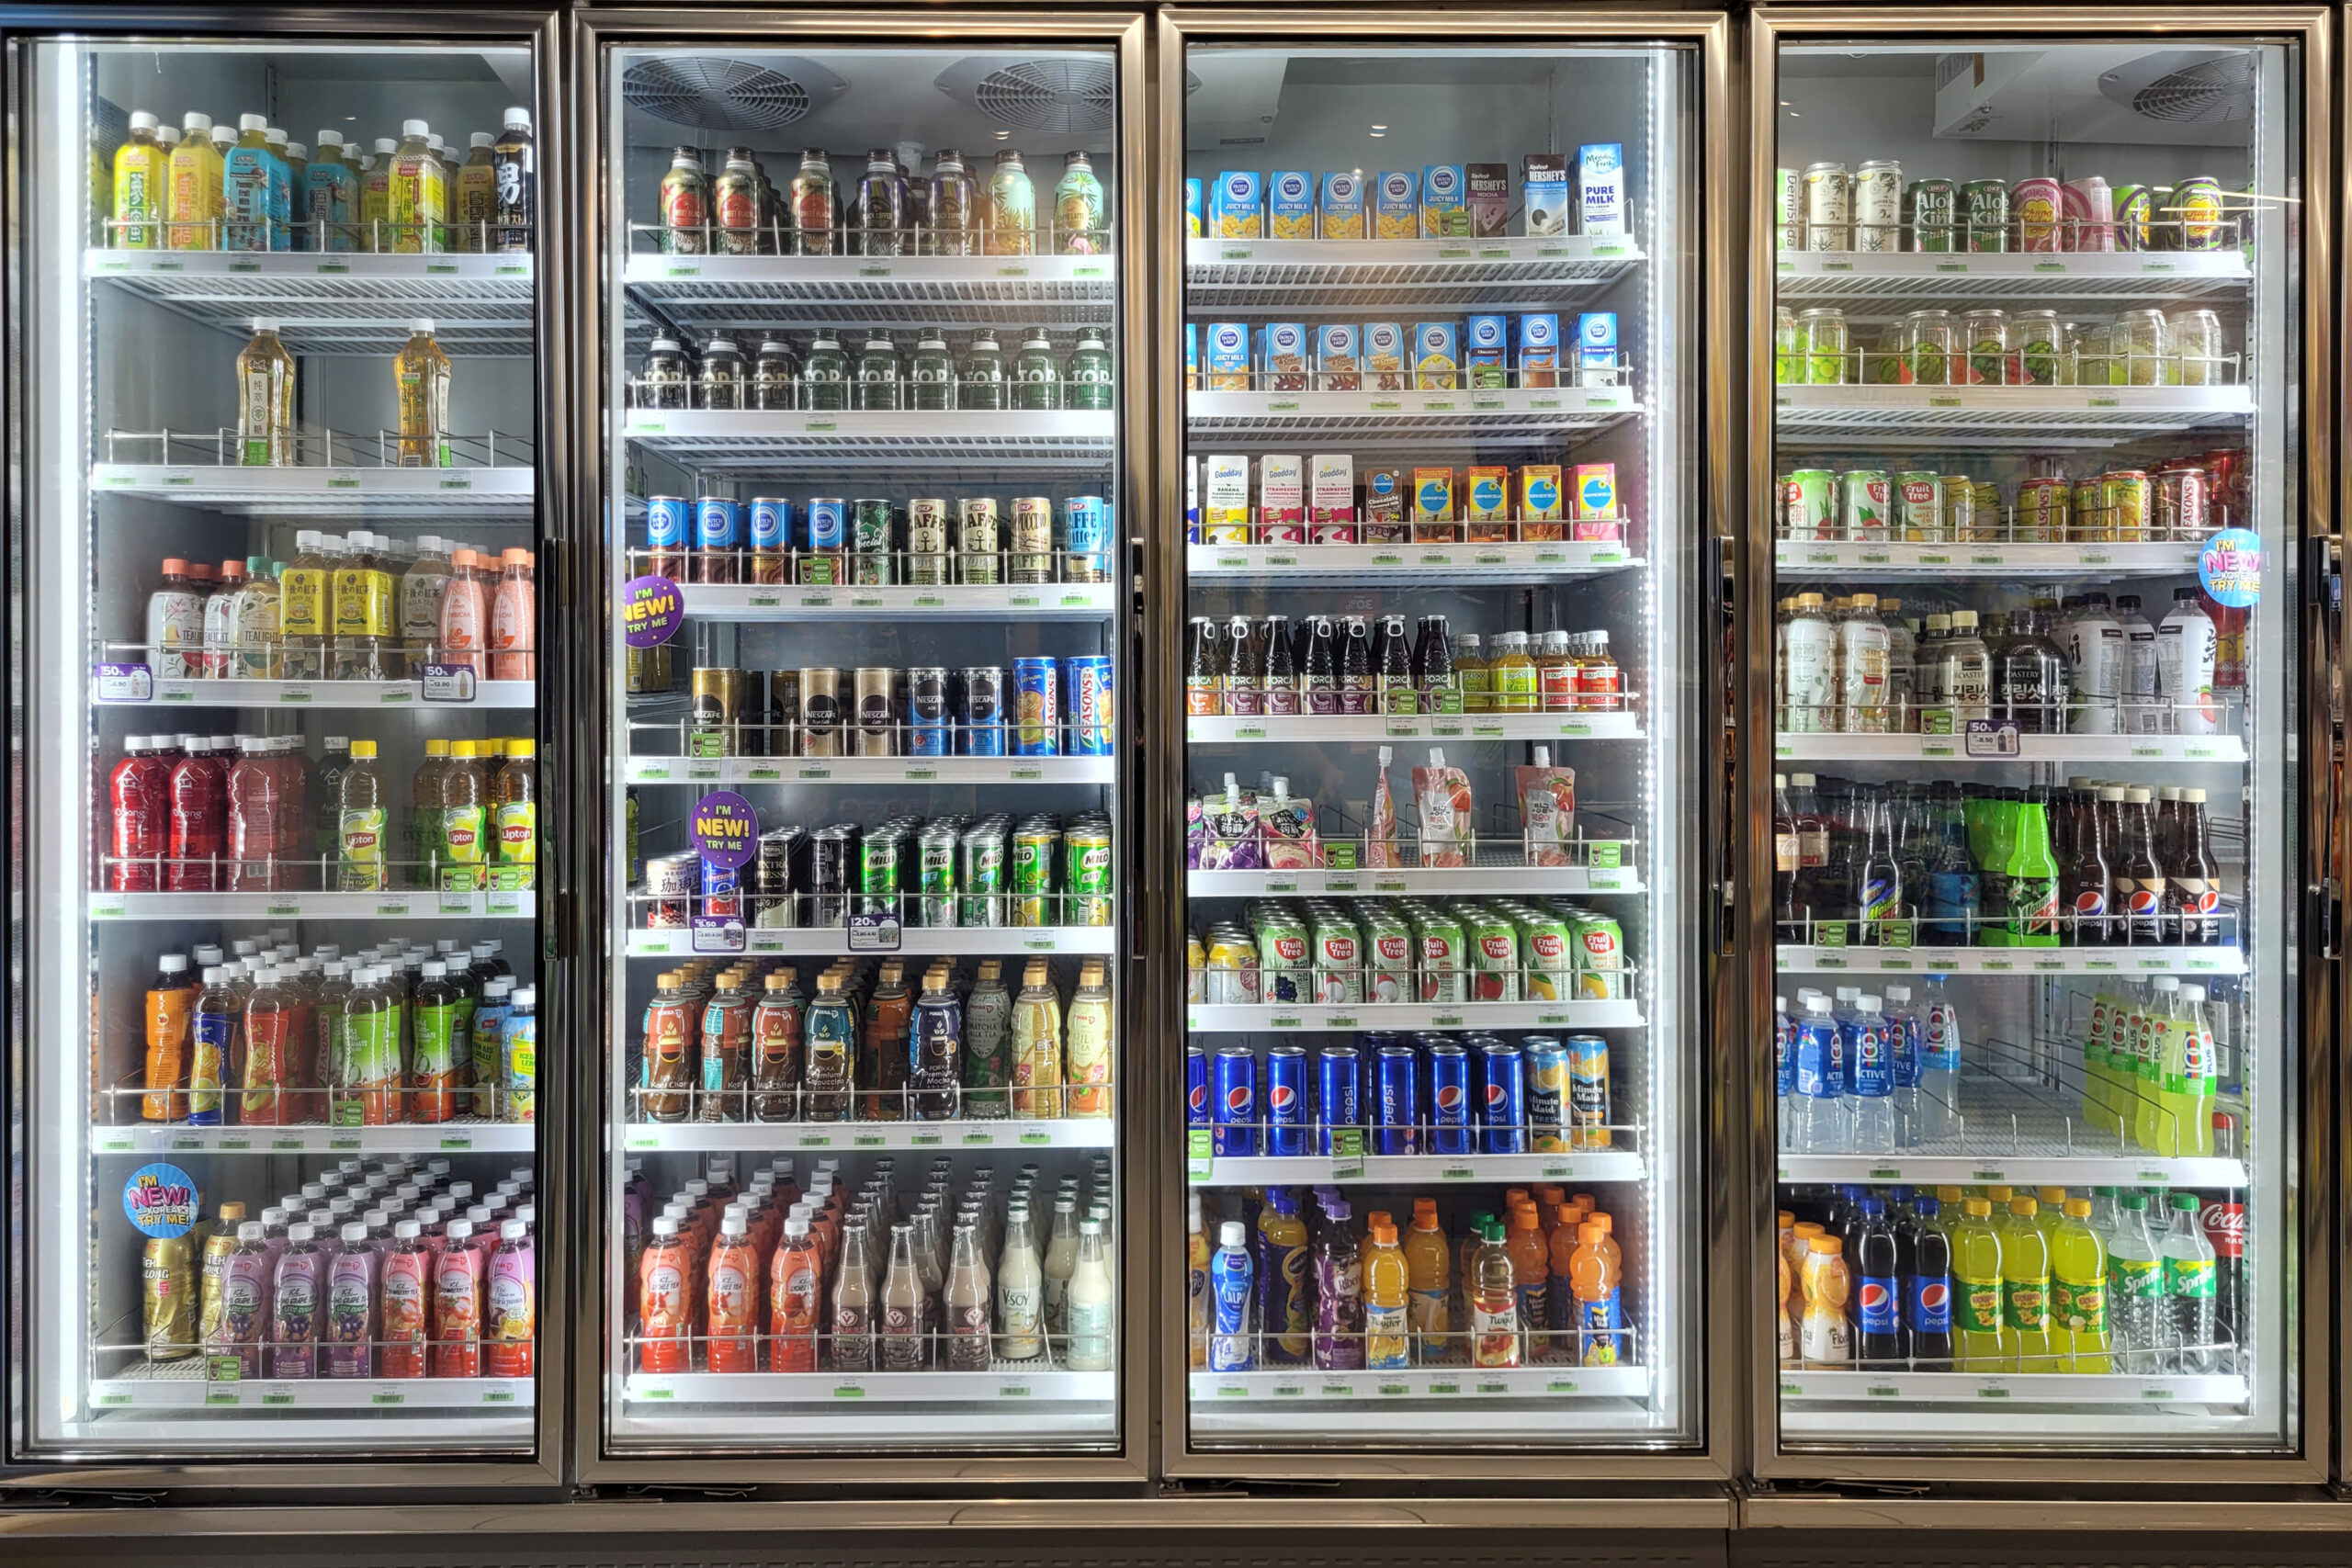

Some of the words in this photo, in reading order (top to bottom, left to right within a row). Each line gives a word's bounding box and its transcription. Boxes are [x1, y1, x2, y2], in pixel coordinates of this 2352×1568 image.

[1529, 170, 1566, 183] HERSHEY'S
[1471, 179, 1507, 191] HERSHEY'S
[1585, 186, 1615, 196] PURE
[1585, 195, 1615, 205] MILK
[1918, 193, 1955, 209] Aloe
[1973, 192, 2009, 209] Aloe
[1787, 175, 1797, 247] DemiSoda
[2023, 208, 2053, 220] Chupa
[1214, 354, 1230, 362] JUICY
[1071, 369, 1111, 387] TOP
[1215, 468, 1243, 479] Goodday
[1269, 468, 1297, 479] Goodday
[1319, 468, 1347, 479] Goodday
[1905, 484, 1929, 494] Fruit
[1907, 491, 1929, 501] Tree
[971, 503, 987, 512] OKF
[908, 512, 945, 534] CAFFE
[2215, 539, 2235, 552] I'M
[2209, 580, 2234, 592] TRY
[2239, 580, 2260, 592] ME
[635, 587, 653, 599] I'M
[622, 594, 675, 623] NEW!
[627, 622, 649, 635] TRY
[651, 616, 668, 628] ME
[244, 630, 280, 642] TEALIGHT
[1424, 674, 1451, 683] FORCA
[1971, 722, 1993, 732] 50%
[716, 805, 731, 816] I'M
[696, 818, 750, 838] NEW!
[347, 834, 374, 846] Lipton
[449, 832, 473, 844] Lipton
[502, 829, 531, 840] Lipton
[706, 840, 724, 851] TRY
[727, 840, 742, 851] ME
[868, 854, 895, 866] MILO
[924, 855, 950, 866] MILO
[1084, 853, 1109, 865] MILO
[854, 917, 876, 927] 20%
[2078, 919, 2104, 928] pepsi
[2132, 919, 2158, 928] pepsi
[1383, 940, 1406, 949] Fruit
[1486, 939, 1509, 949] Fruit
[1537, 937, 1560, 947] Fruit
[1587, 934, 1609, 944] Fruit
[1280, 941, 1303, 950] Fruit
[1329, 942, 1352, 951] Fruit
[1488, 946, 1508, 956] Tree
[1539, 944, 1559, 953] Tree
[1590, 942, 1610, 951] Tree
[1283, 948, 1302, 956] Tree
[1330, 948, 1351, 958] Tree
[1385, 947, 1405, 957] Tree
[2183, 1032, 2204, 1077] 100
[1572, 1084, 1604, 1094] Minute
[1529, 1094, 1560, 1106] Minute
[1576, 1091, 1600, 1102] Maid
[1343, 1086, 1354, 1125] pepsi
[1385, 1084, 1396, 1125] pepsi
[1532, 1104, 1556, 1113] Maid
[1440, 1115, 1464, 1124] pepsi
[1485, 1113, 1507, 1123] pepsi
[139, 1174, 158, 1189] I'M
[129, 1186, 191, 1208] NEW!
[138, 1214, 164, 1227] TRY
[166, 1214, 190, 1225] ME!
[2201, 1203, 2244, 1229] Coca
[2123, 1266, 2159, 1295] Sprite
[2177, 1266, 2213, 1295] Sprite
[1861, 1316, 1888, 1327] pepsi
[1924, 1316, 1949, 1327] pepsi
